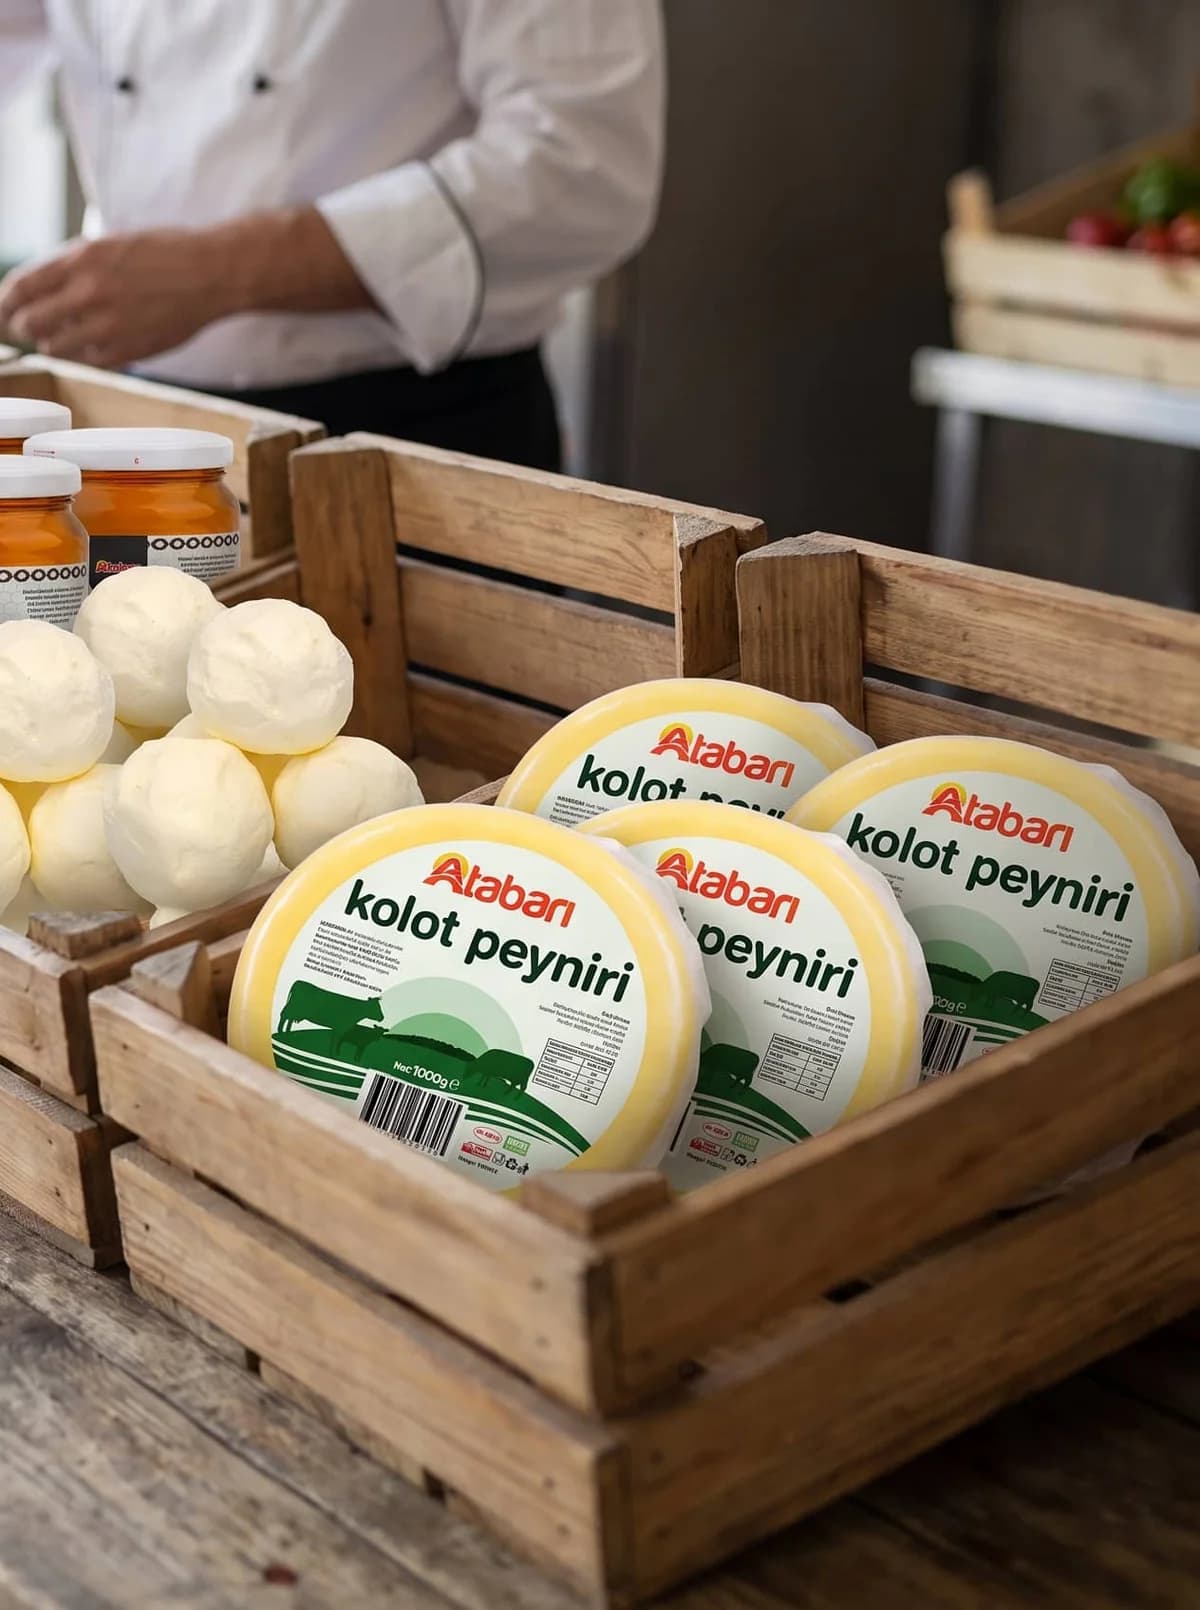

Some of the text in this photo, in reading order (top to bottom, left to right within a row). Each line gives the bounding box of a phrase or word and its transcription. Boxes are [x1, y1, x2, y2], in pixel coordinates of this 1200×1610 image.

[577, 754, 687, 801] kolot
[846, 812, 960, 876] kolot
[965, 854, 1135, 922] peyniri
[344, 878, 461, 948] kolot
[464, 928, 635, 1003] peyniri
[697, 923, 859, 998] peyniri
